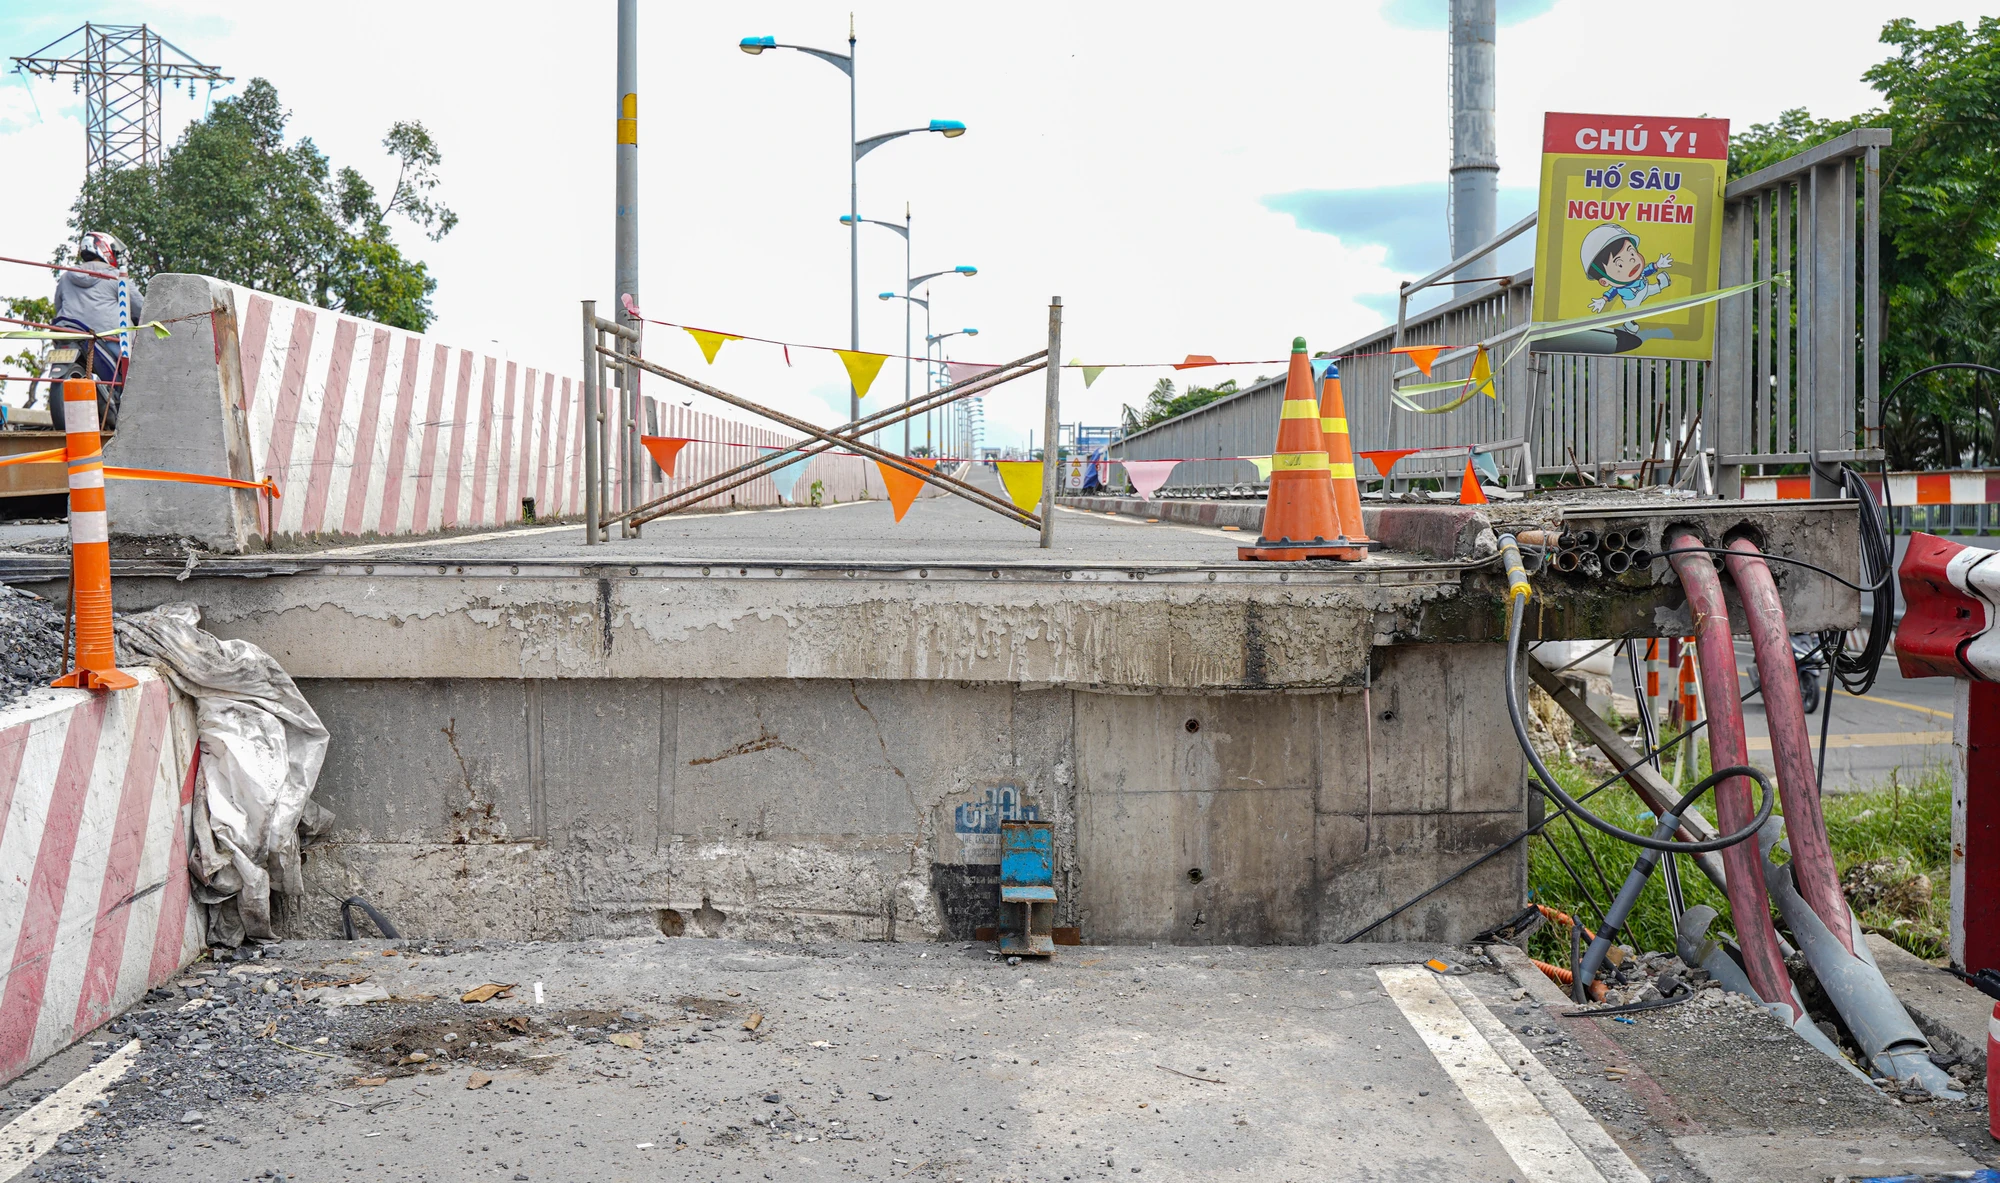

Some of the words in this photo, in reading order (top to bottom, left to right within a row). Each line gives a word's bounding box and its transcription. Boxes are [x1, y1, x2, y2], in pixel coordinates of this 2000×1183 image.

[1575, 123, 1648, 152] CHÚ
[1659, 125, 1698, 153] Ý!
[1585, 163, 1626, 188] HỐ
[1629, 167, 1682, 191] SÂU
[1567, 200, 1631, 222] NGUY
[1637, 194, 1694, 224] HIỂM
